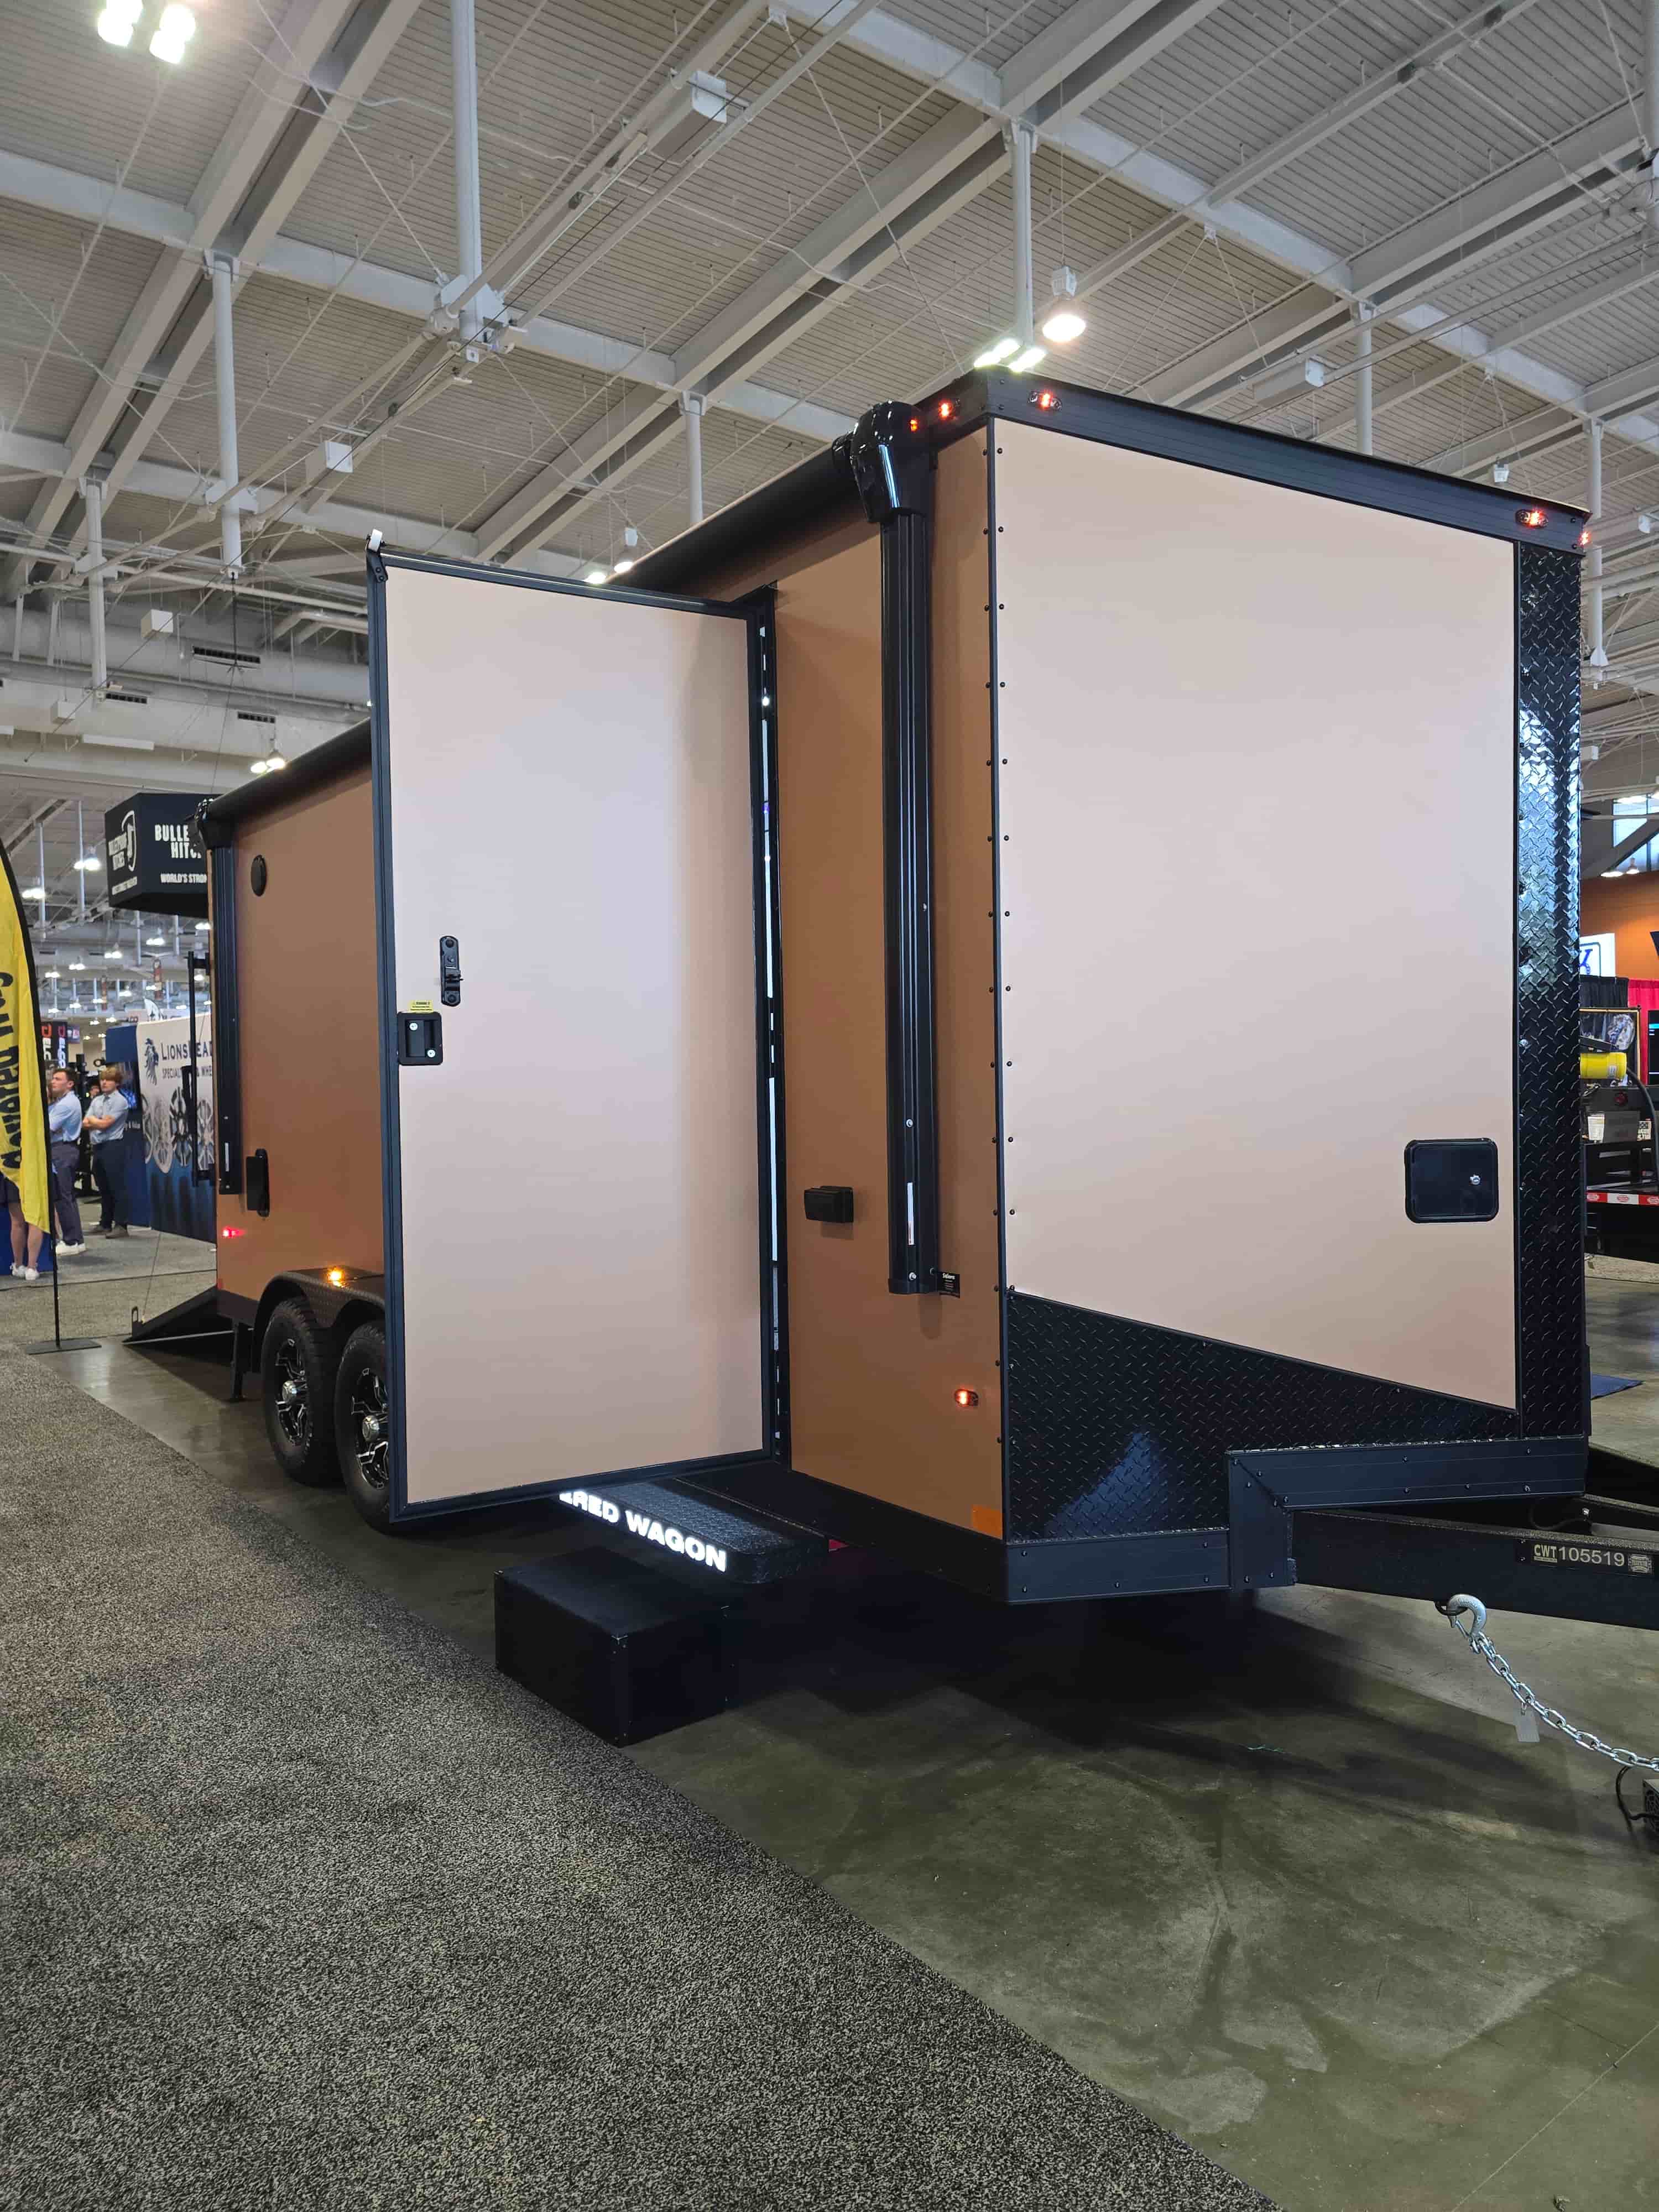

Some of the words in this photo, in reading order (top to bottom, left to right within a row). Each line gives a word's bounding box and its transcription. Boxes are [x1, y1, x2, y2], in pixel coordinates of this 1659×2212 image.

[154, 824, 190, 842] BULLE
[160, 873, 187, 883] WORLD'S
[625, 1510, 727, 1572] WAGON
[1533, 1544, 1557, 1558] CWT
[1558, 1546, 1625, 1567] 105519
